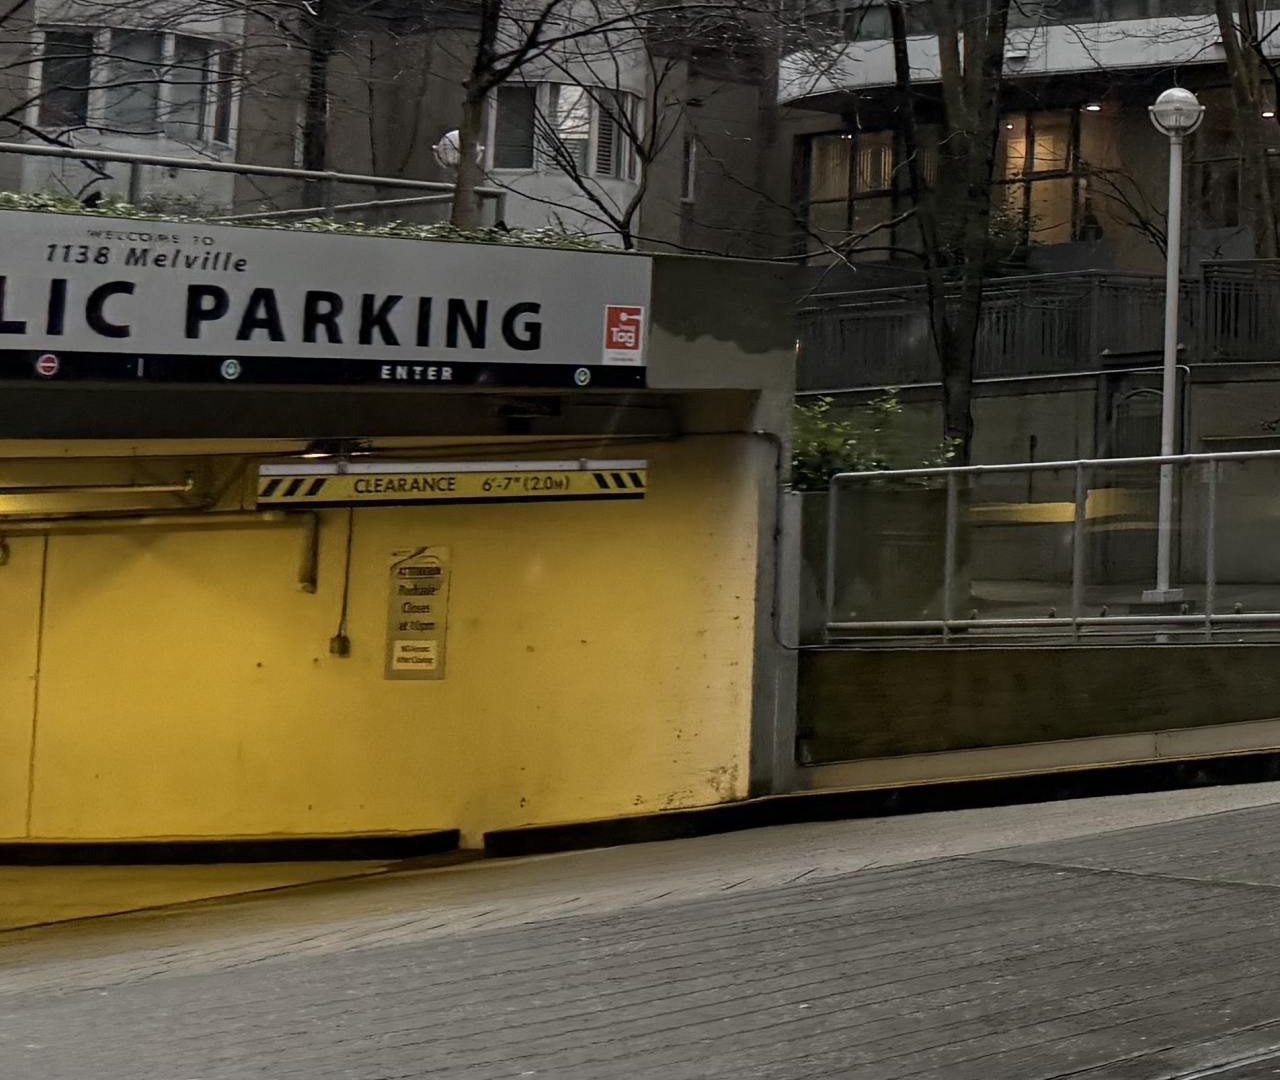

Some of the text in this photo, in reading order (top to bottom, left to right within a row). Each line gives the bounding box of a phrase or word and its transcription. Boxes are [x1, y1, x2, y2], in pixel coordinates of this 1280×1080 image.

[87, 230, 181, 244] WELCOME
[47, 243, 248, 272] 1138 Melville
[0, 275, 543, 351] LIC PARKING
[610, 327, 636, 347] Tag
[381, 365, 453, 380] ENTER
[353, 477, 456, 494] CLEARANCE
